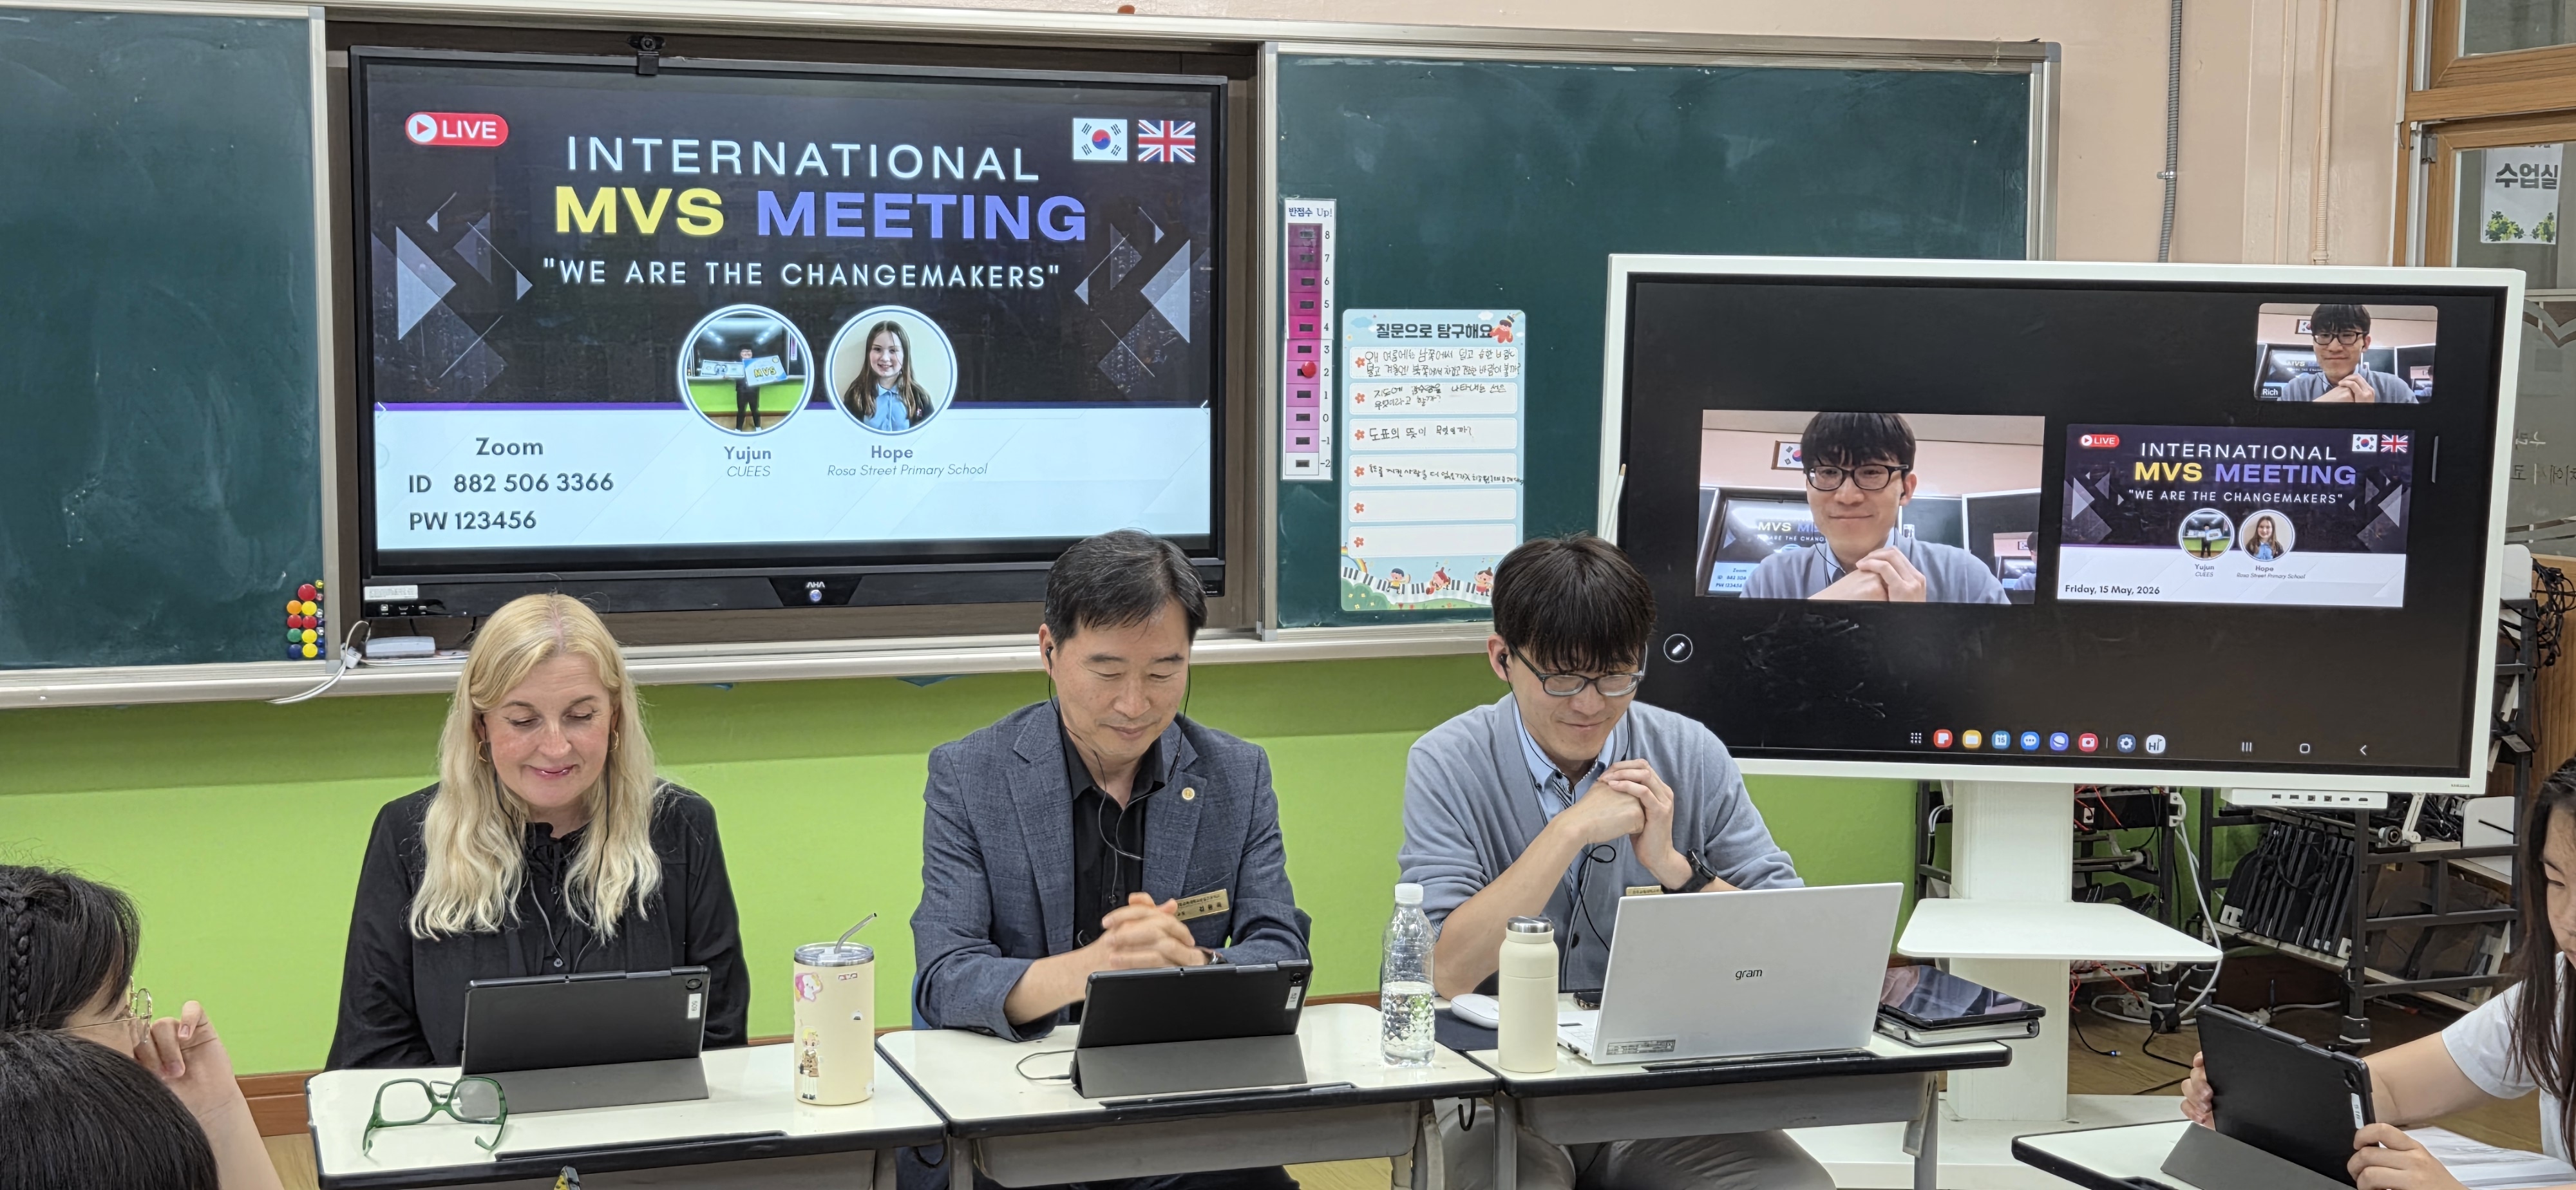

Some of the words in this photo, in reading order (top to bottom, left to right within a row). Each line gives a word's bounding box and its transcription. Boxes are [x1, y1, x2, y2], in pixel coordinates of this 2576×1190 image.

[442, 120, 497, 139] LIVE
[568, 136, 1039, 181] INTERNATIONAL
[2495, 163, 2559, 190] 수업실
[556, 186, 724, 236] MVS
[757, 191, 1086, 241] MEETING
[1289, 207, 1313, 217] 반점수
[1316, 208, 1332, 218] Up!
[1325, 231, 1331, 240] 8
[1325, 254, 1330, 262] 7
[544, 258, 605, 283] "WE
[625, 261, 686, 284] ARE
[706, 262, 762, 285] THE
[781, 263, 1059, 288] CHANGEMAKERS"
[1324, 277, 1330, 285] 6
[1324, 299, 1329, 308] 5
[1323, 323, 1329, 331] 4
[1376, 323, 1433, 339] 질문으로
[1437, 323, 1493, 339] 탐구해요
[1324, 345, 1330, 354] 3
[753, 366, 777, 378] MVS
[1323, 368, 1329, 377] 2
[1324, 391, 1328, 399] 1
[1323, 413, 1329, 422] 0
[476, 437, 544, 455] Zoom
[1321, 437, 1331, 445] -1
[2093, 436, 2116, 446] LIVE
[724, 446, 772, 464] Yujun
[871, 446, 913, 462] Hope
[2141, 442, 2338, 460] INTERNATIONAL
[1320, 459, 1331, 468] -2
[726, 465, 771, 477] CUEES
[828, 464, 857, 477] Rosa
[860, 464, 897, 476] Street
[900, 463, 945, 478] Primary
[947, 462, 988, 476] School
[2134, 462, 2202, 482] MVS
[2214, 464, 2356, 484] MEETING
[408, 474, 432, 493] ID
[453, 473, 497, 493] 882
[504, 473, 549, 492] 506
[556, 472, 614, 491] 3366
[2128, 489, 2154, 501] "WE
[2159, 490, 2185, 502] ARE
[2192, 491, 2216, 502] THE
[2223, 491, 2342, 504] CHANGEMAKERS"
[409, 512, 448, 531] PW
[455, 511, 537, 530] 123456
[1757, 522, 1792, 531] MVS
[2065, 583, 2097, 596] Friday,
[2099, 585, 2109, 594] 15
[2110, 585, 2134, 596] May,
[2136, 586, 2160, 594] 2026
[1735, 969, 1763, 980] gram
